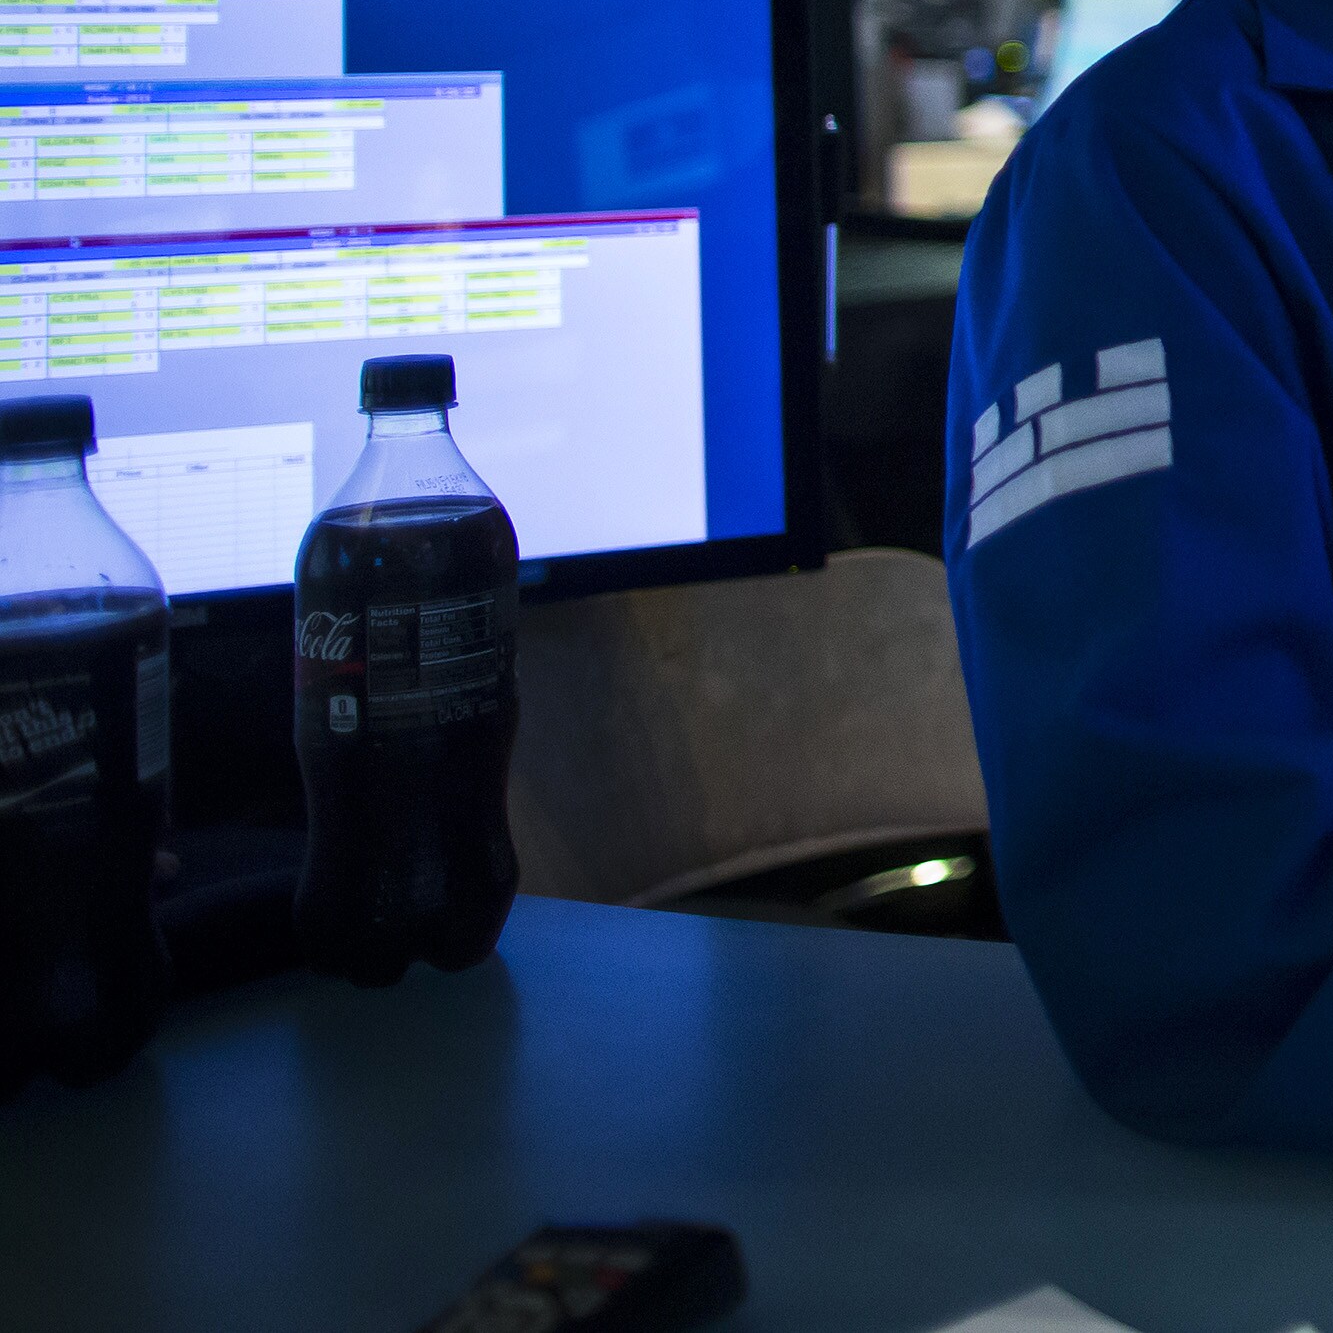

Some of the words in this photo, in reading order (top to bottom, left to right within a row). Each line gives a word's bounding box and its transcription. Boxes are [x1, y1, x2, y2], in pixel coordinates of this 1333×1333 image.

[370, 607, 416, 618] Nutrition
[370, 618, 399, 627] Facts
[338, 699, 347, 714] 0
